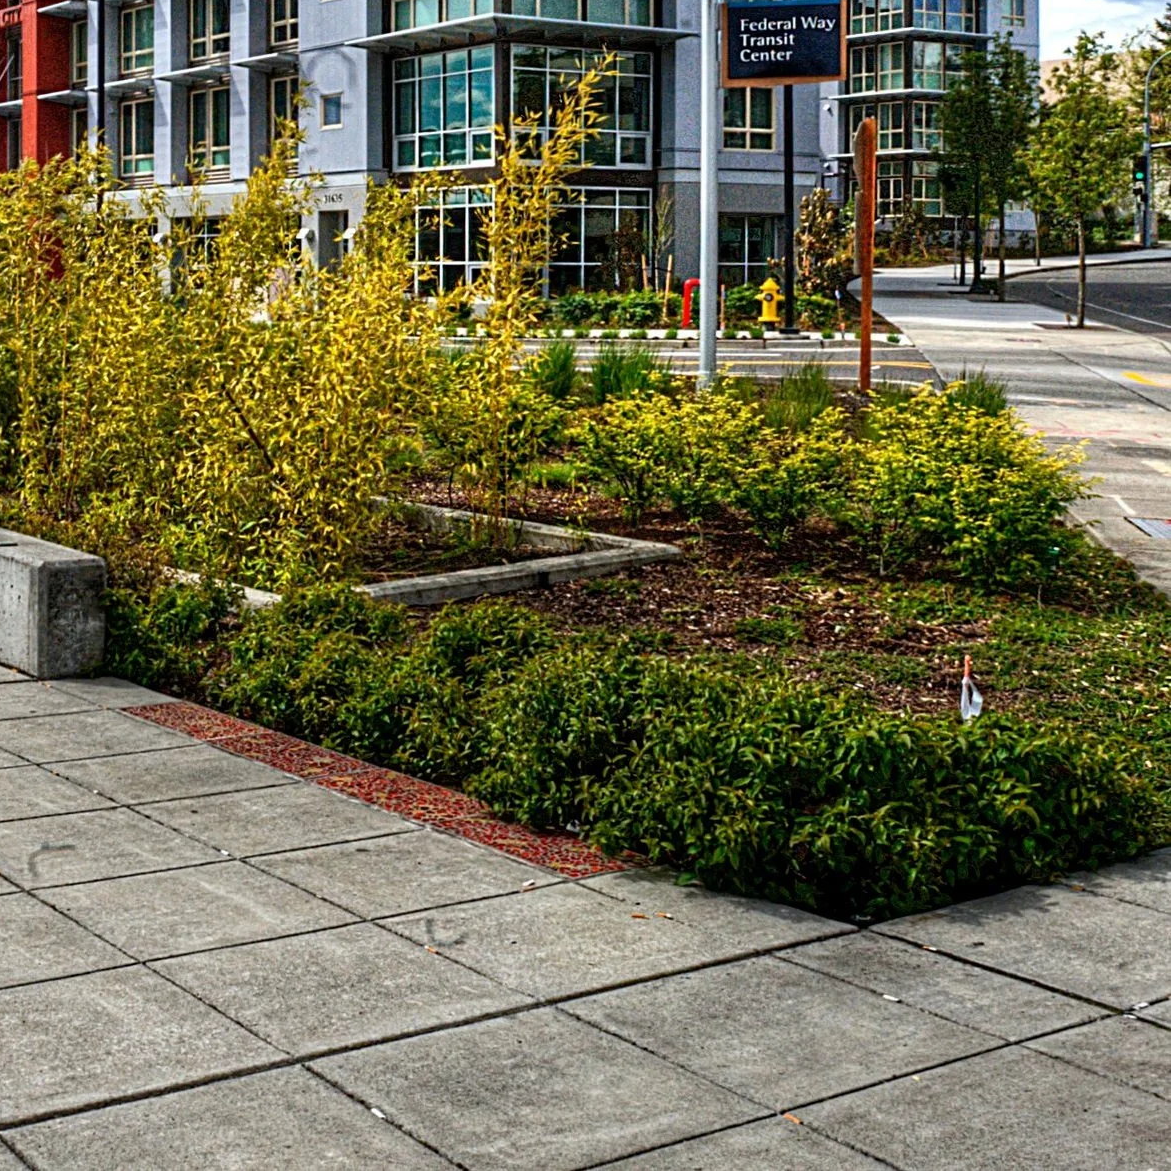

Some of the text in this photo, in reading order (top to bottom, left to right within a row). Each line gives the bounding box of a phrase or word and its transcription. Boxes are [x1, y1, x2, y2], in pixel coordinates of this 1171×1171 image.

[739, 16, 836, 32] Federal Way
[739, 33, 795, 47] Transit
[739, 49, 793, 62] Center
